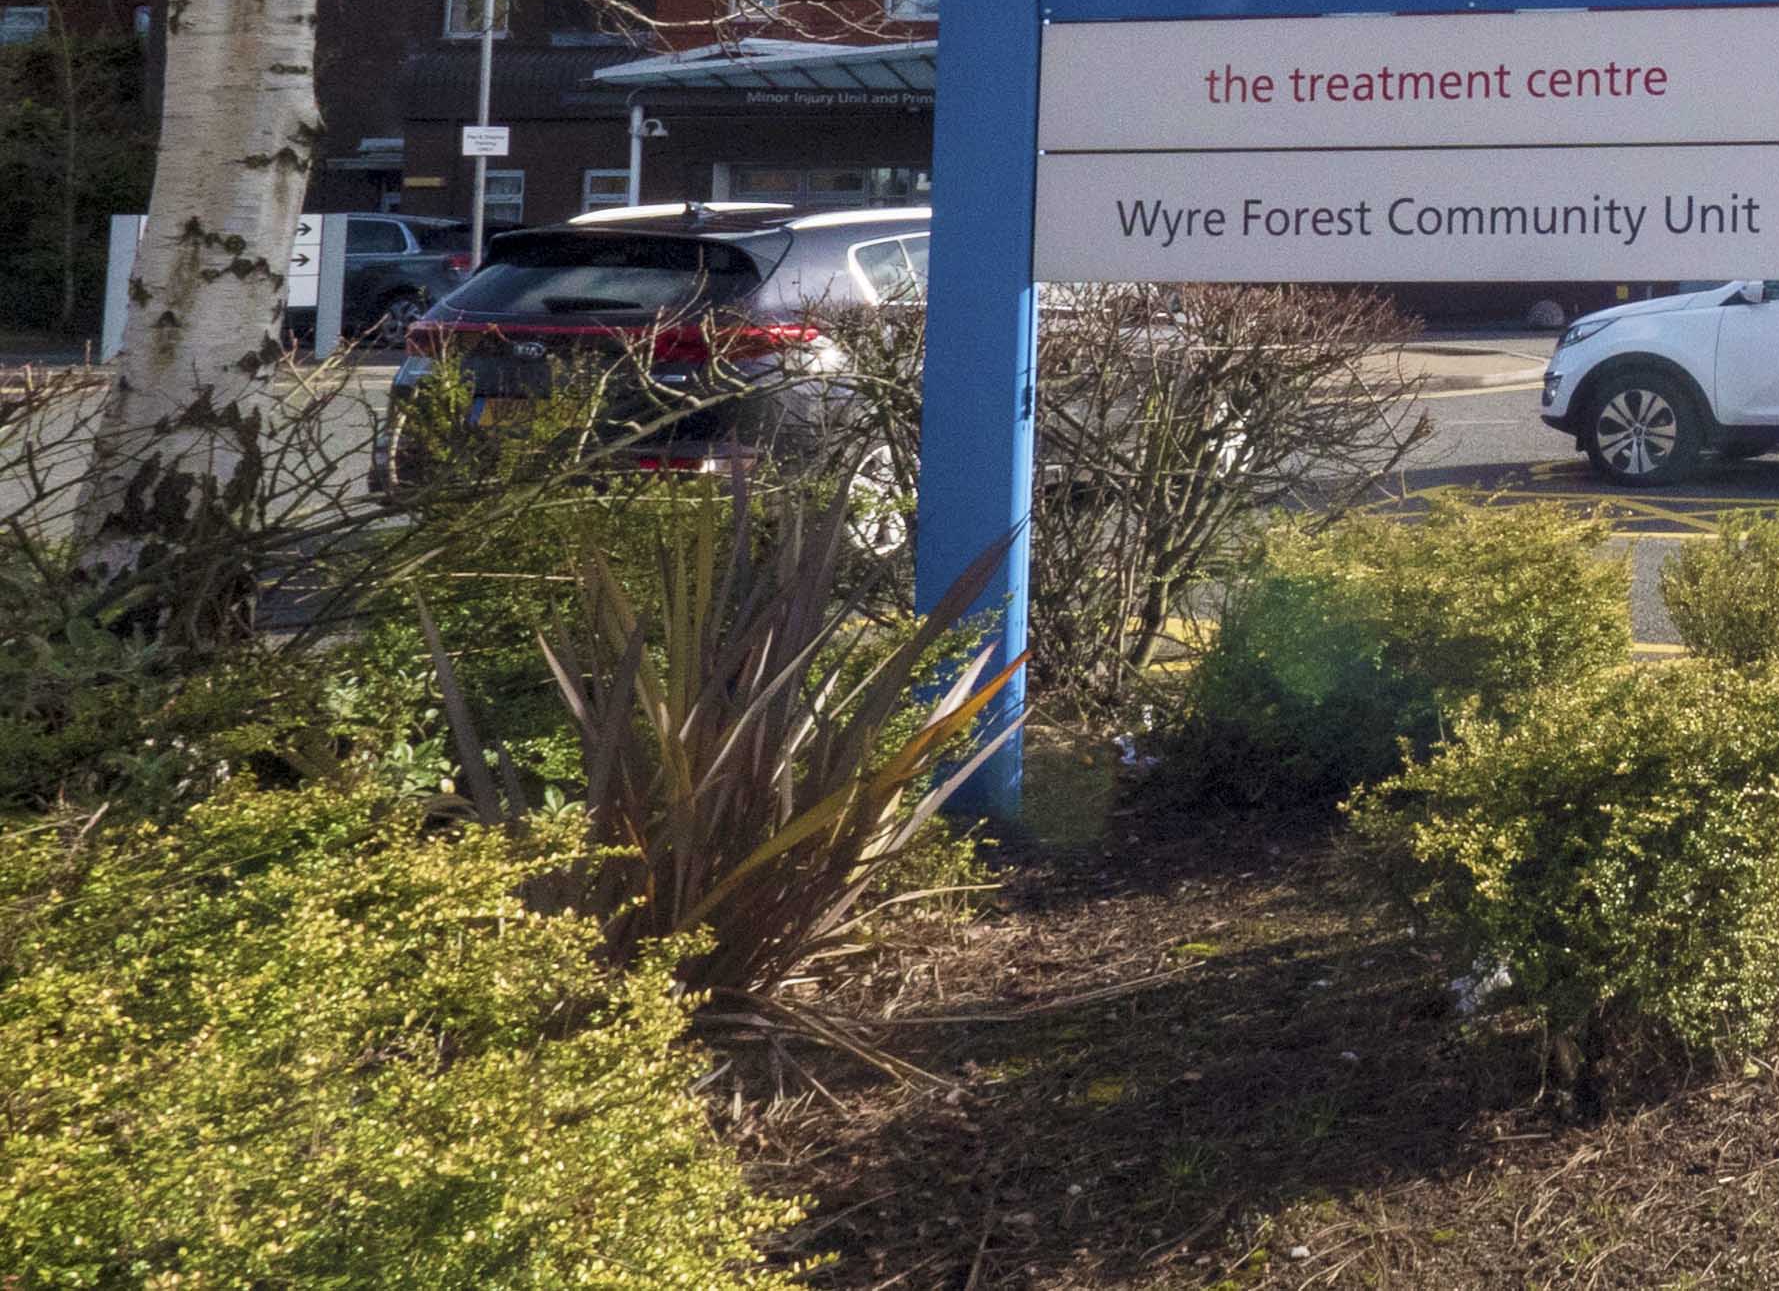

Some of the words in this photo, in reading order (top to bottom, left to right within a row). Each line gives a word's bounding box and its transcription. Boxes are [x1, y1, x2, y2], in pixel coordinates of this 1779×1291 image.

[747, 92, 789, 103] Minor
[794, 92, 834, 105] Injury
[838, 92, 868, 103] Unit
[872, 93, 898, 104] and
[1205, 64, 1274, 103] the
[1289, 65, 1510, 103] treatment
[1527, 62, 1667, 98] centre
[1117, 200, 1226, 248] Wyre
[1243, 199, 1371, 236] Forest
[1388, 195, 1646, 245] Community
[1665, 193, 1760, 234] Unit
